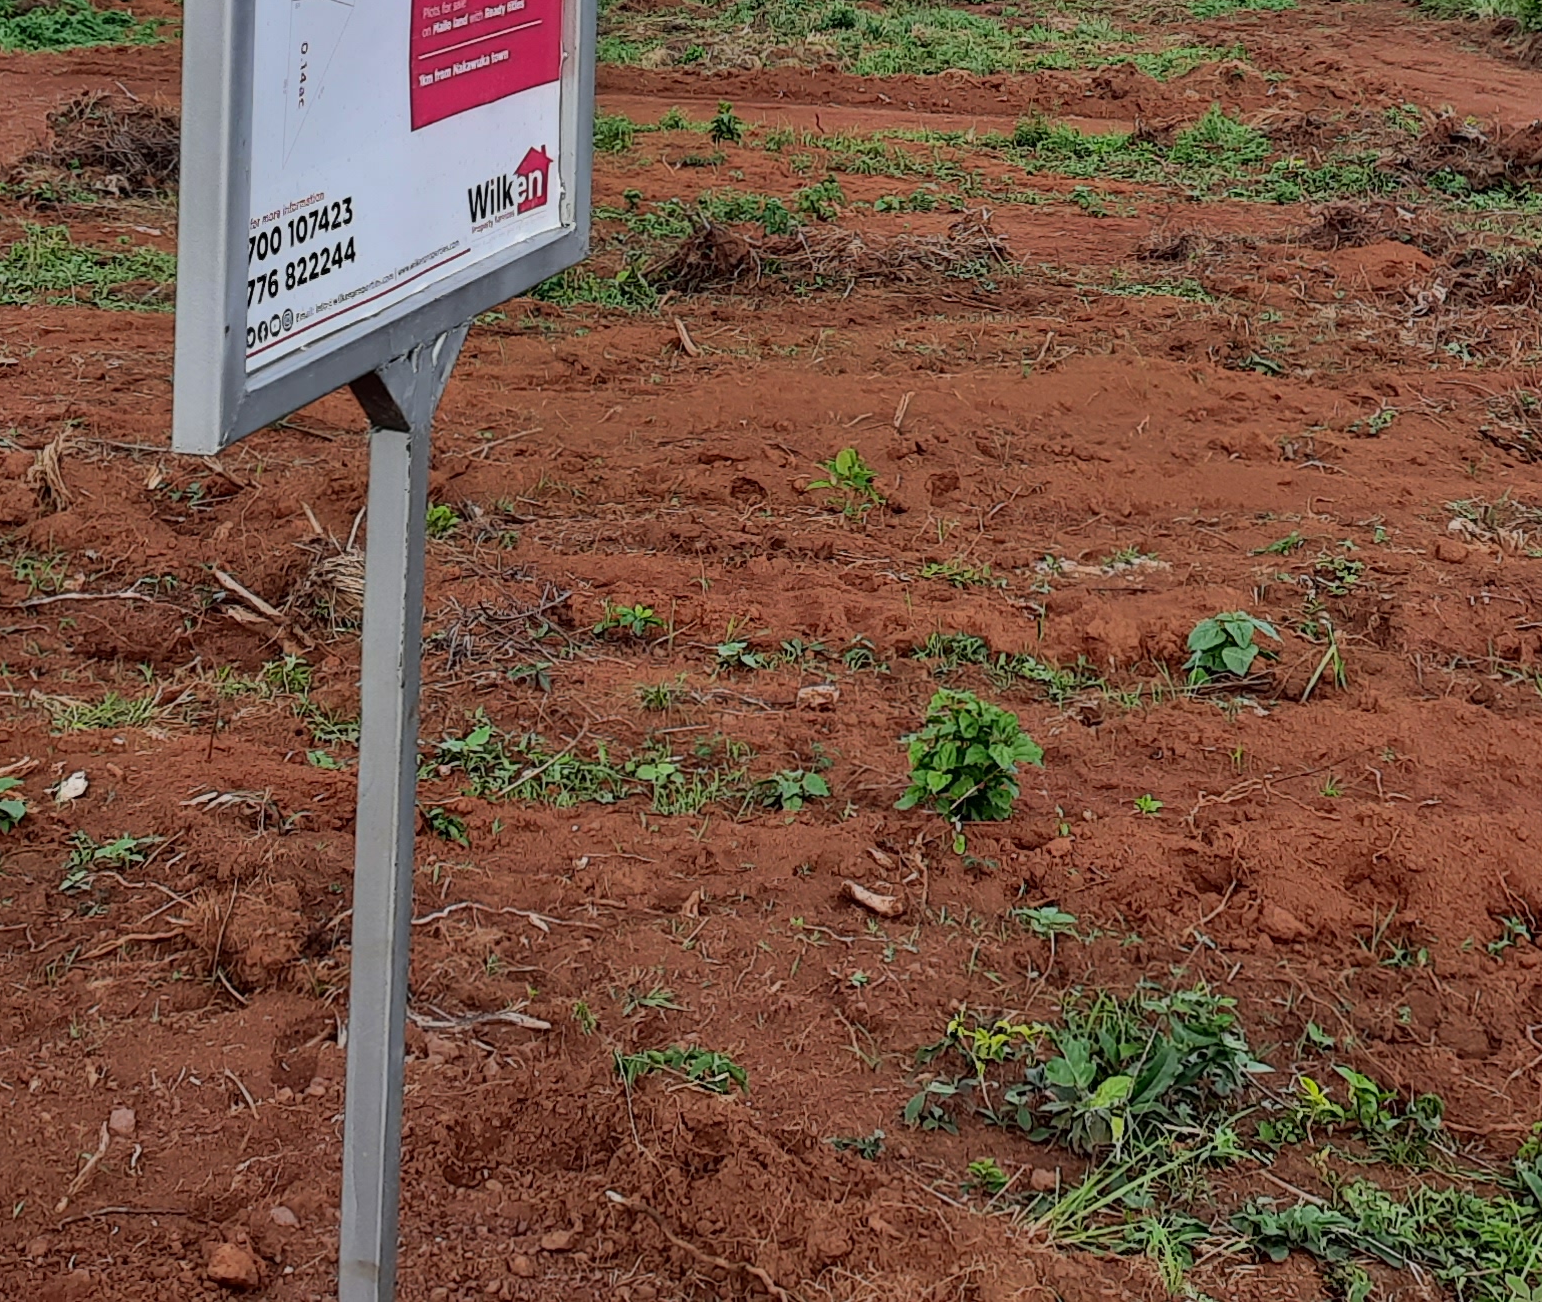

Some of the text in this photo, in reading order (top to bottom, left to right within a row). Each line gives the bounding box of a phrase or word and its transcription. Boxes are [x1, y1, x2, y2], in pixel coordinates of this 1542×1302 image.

[442, 2, 452, 14] for
[288, 196, 353, 248] 107423
[468, 169, 543, 223] Wilken
[285, 236, 356, 291] 822244
